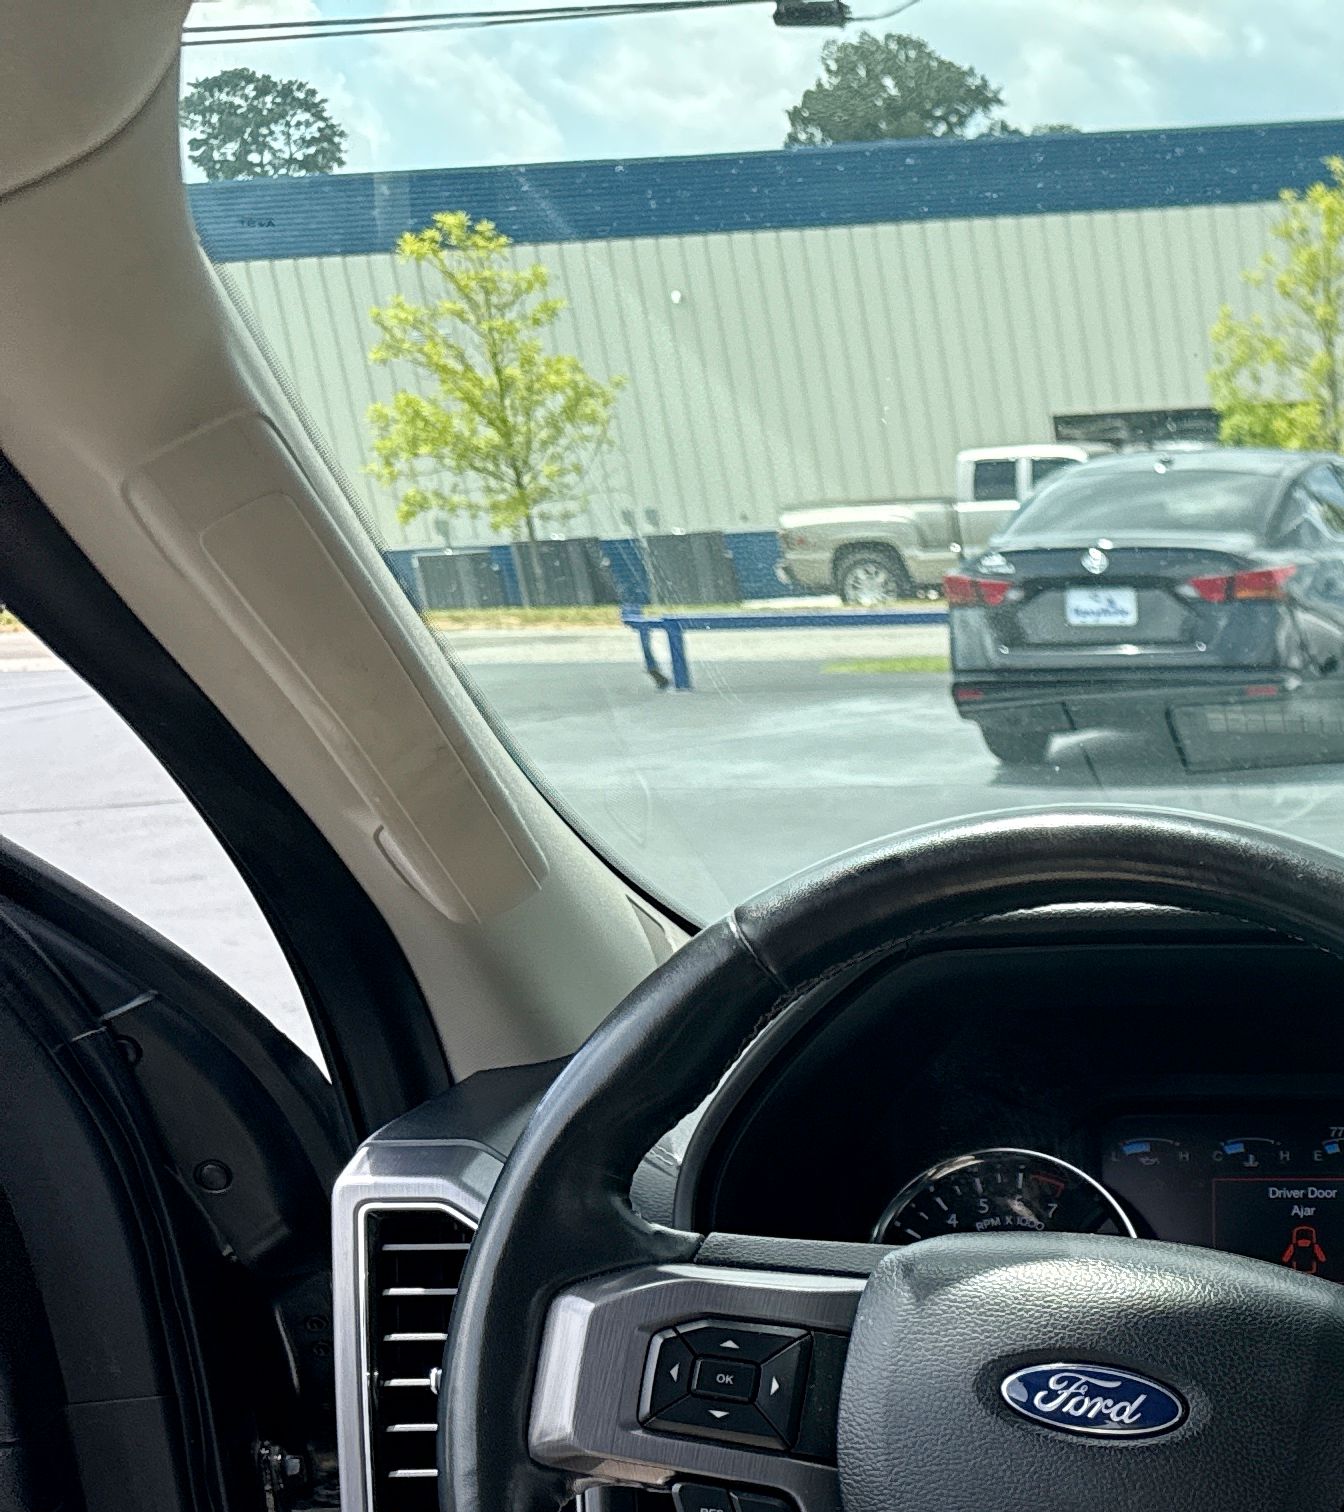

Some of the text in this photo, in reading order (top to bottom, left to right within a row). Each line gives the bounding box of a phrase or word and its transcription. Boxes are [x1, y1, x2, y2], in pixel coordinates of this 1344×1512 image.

[1330, 1127, 1344, 1137] 77
[1268, 1187, 1338, 1198] Driver Door
[979, 1199, 990, 1214] 5
[1048, 1204, 1057, 1218] 7
[1291, 1205, 1316, 1218] Ajar
[946, 1213, 959, 1228] 4
[976, 1216, 1001, 1231] RPM
[1016, 1216, 1046, 1231] 1000
[716, 1373, 734, 1385] OK
[1033, 1372, 1147, 1424] Ford
